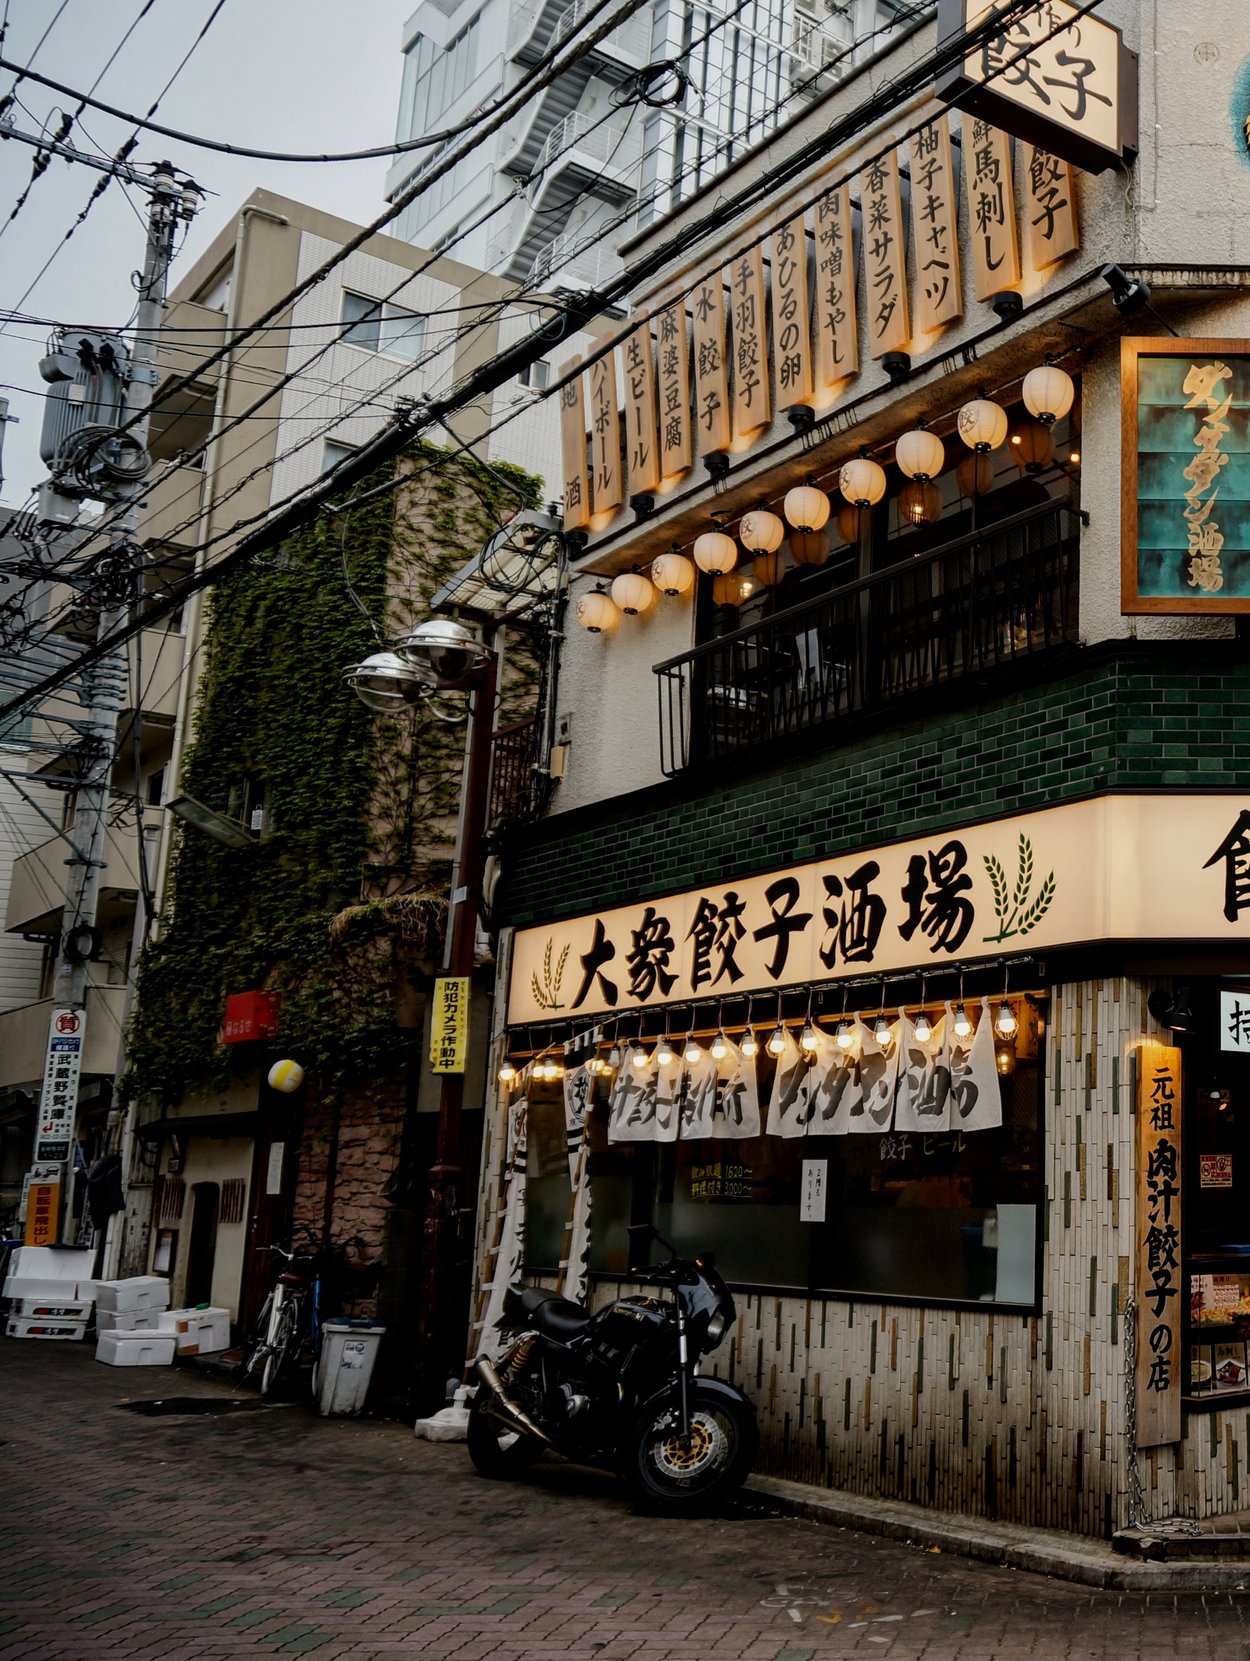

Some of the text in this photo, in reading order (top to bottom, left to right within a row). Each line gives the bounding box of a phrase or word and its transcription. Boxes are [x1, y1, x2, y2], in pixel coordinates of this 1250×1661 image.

[818, 192, 846, 364] 肉味噌もやし
[864, 160, 898, 339] 香菜サラダ
[911, 124, 950, 310] 柚子キャベツ
[695, 286, 721, 433] 水餃子
[734, 258, 760, 408] 手羽餃子
[776, 223, 802, 391] あひるの卵
[561, 380, 582, 512] 地酒
[592, 358, 613, 495] ハイボール
[626, 337, 650, 472] 生ビール
[659, 309, 682, 452] 麻婆豆腐
[570, 839, 976, 1010] 大衆餃子酒場
[438, 981, 459, 1069] 防犯カメラ作動中
[879, 1135, 967, 1161] 餃子 ビール
[1149, 1067, 1175, 1133] 元祖
